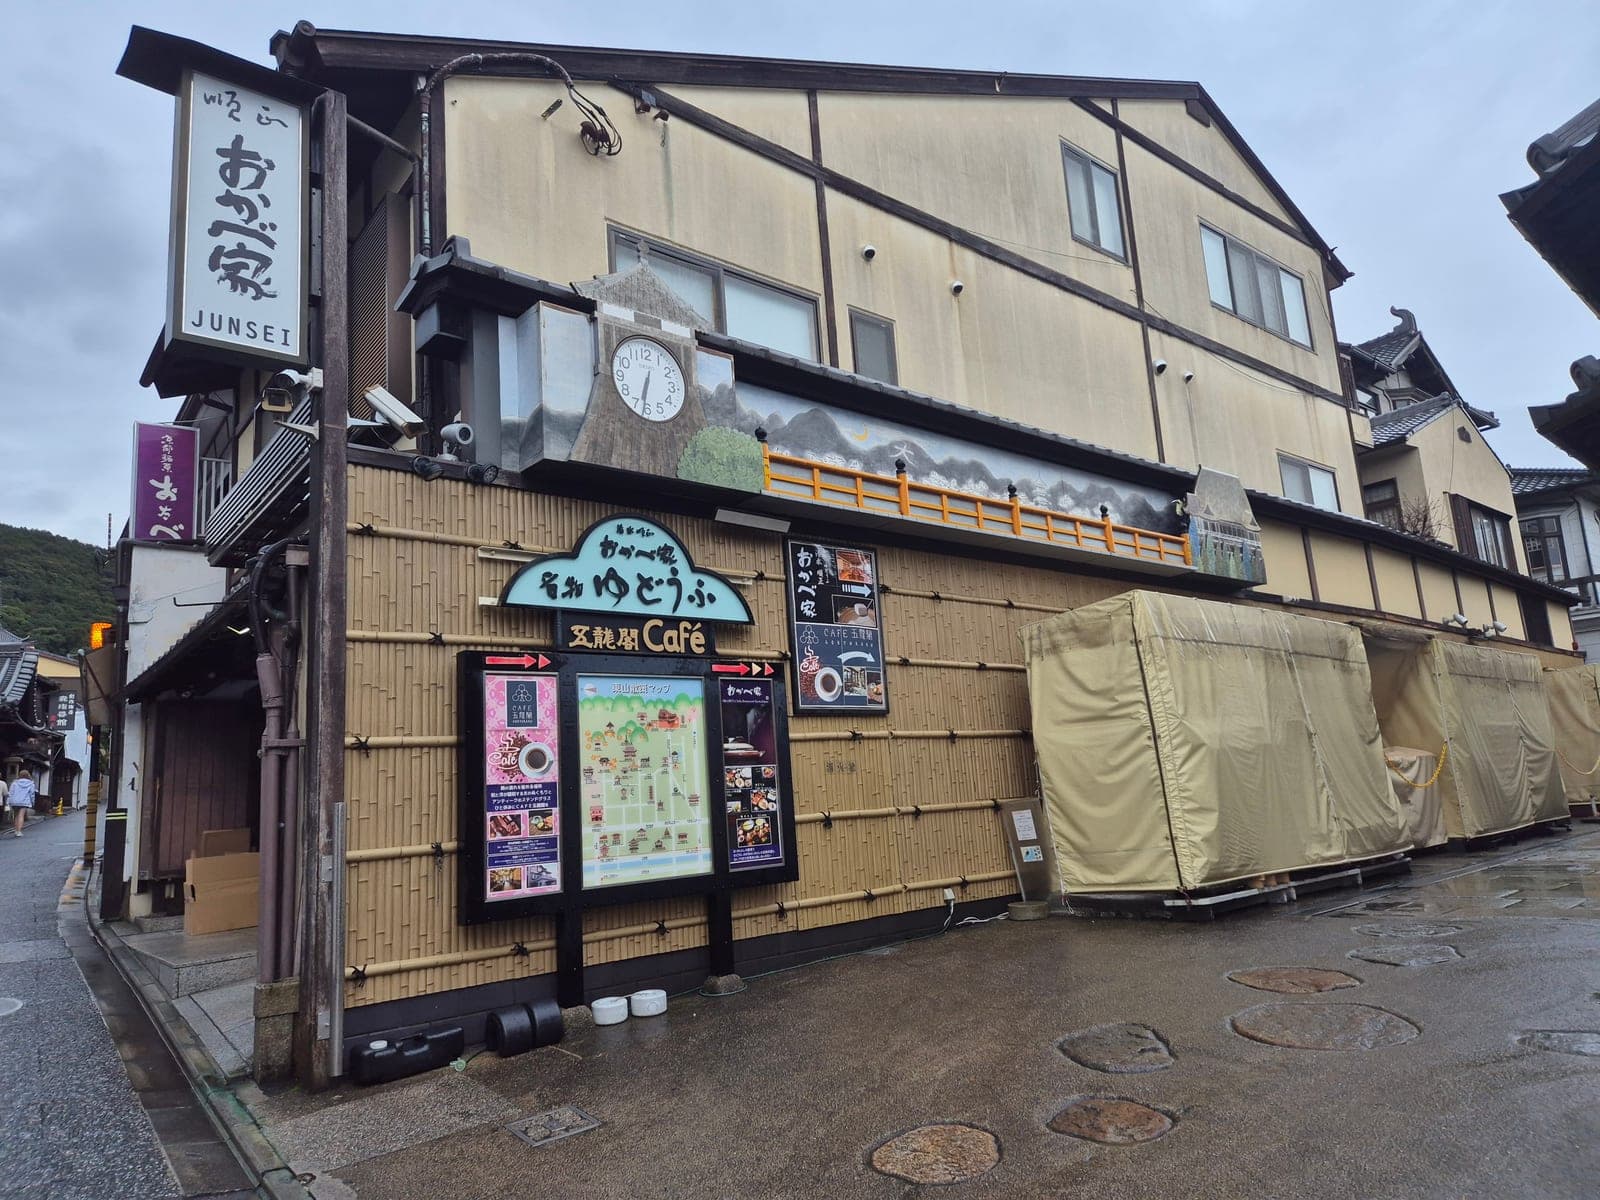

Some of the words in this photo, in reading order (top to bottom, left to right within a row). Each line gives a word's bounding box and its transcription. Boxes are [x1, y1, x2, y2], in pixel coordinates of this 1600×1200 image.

[207, 134, 279, 301] おかべ家
[191, 309, 291, 347] JUNSEI
[629, 348, 638, 360] 11
[641, 348, 652, 361] 12
[619, 356, 631, 369] 10
[616, 369, 625, 381] 9
[664, 366, 672, 378] 2
[621, 383, 630, 396] 8
[668, 381, 676, 393] 3
[631, 396, 640, 408] 7
[665, 394, 673, 406] 4
[644, 403, 652, 416] 6
[656, 402, 664, 414] 5
[599, 534, 678, 566] おかべ家
[796, 546, 818, 619] おかべ家
[593, 566, 717, 614] ゆどうふ
[568, 623, 640, 651] 五龍閣
[642, 618, 706, 654] Café
[823, 627, 849, 639] CAFE
